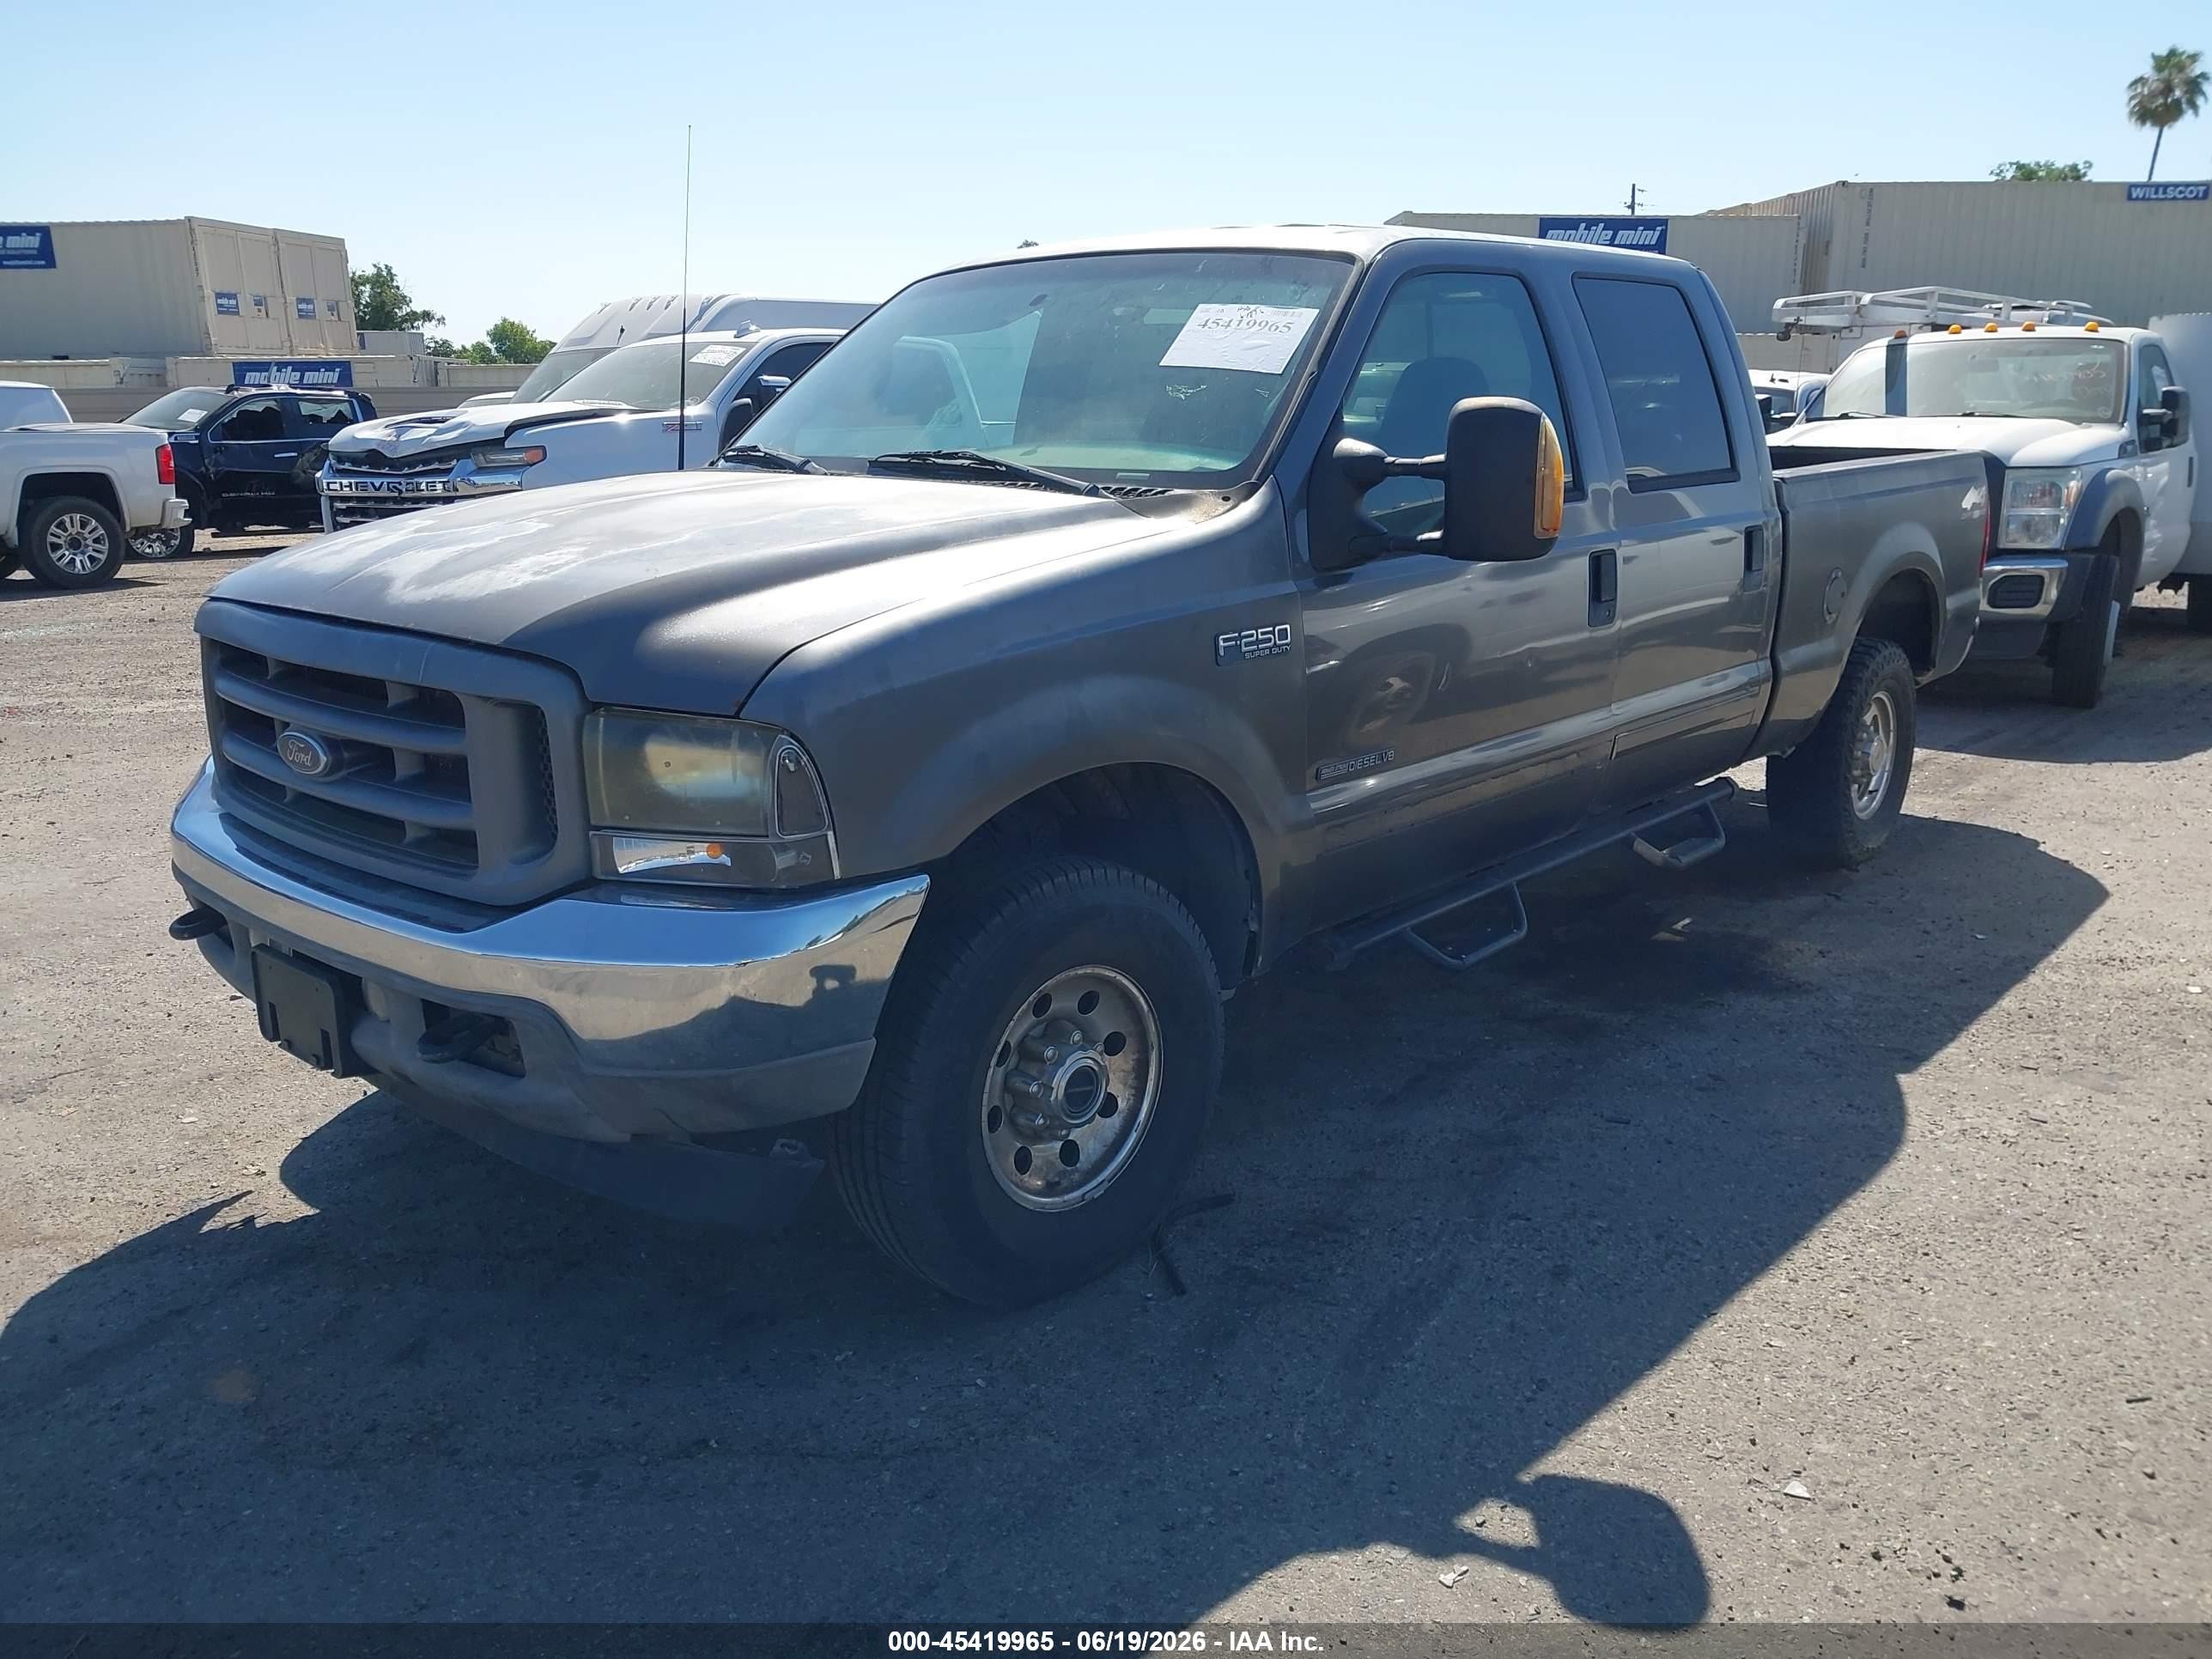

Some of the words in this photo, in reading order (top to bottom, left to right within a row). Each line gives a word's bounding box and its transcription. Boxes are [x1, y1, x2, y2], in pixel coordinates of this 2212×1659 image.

[2130, 186, 2208, 199] WILLSCOT
[1546, 222, 1613, 246] mobile
[1614, 226, 1662, 246] mini
[1197, 318, 1295, 334] 45419965
[244, 365, 301, 385] mobile
[302, 368, 341, 385] mini
[1244, 649, 1270, 659] SUPER
[1271, 645, 1291, 654] DUTY
[287, 738, 313, 767] Ford
[1348, 755, 1382, 772] DIESEL
[1382, 750, 1395, 763] V8
